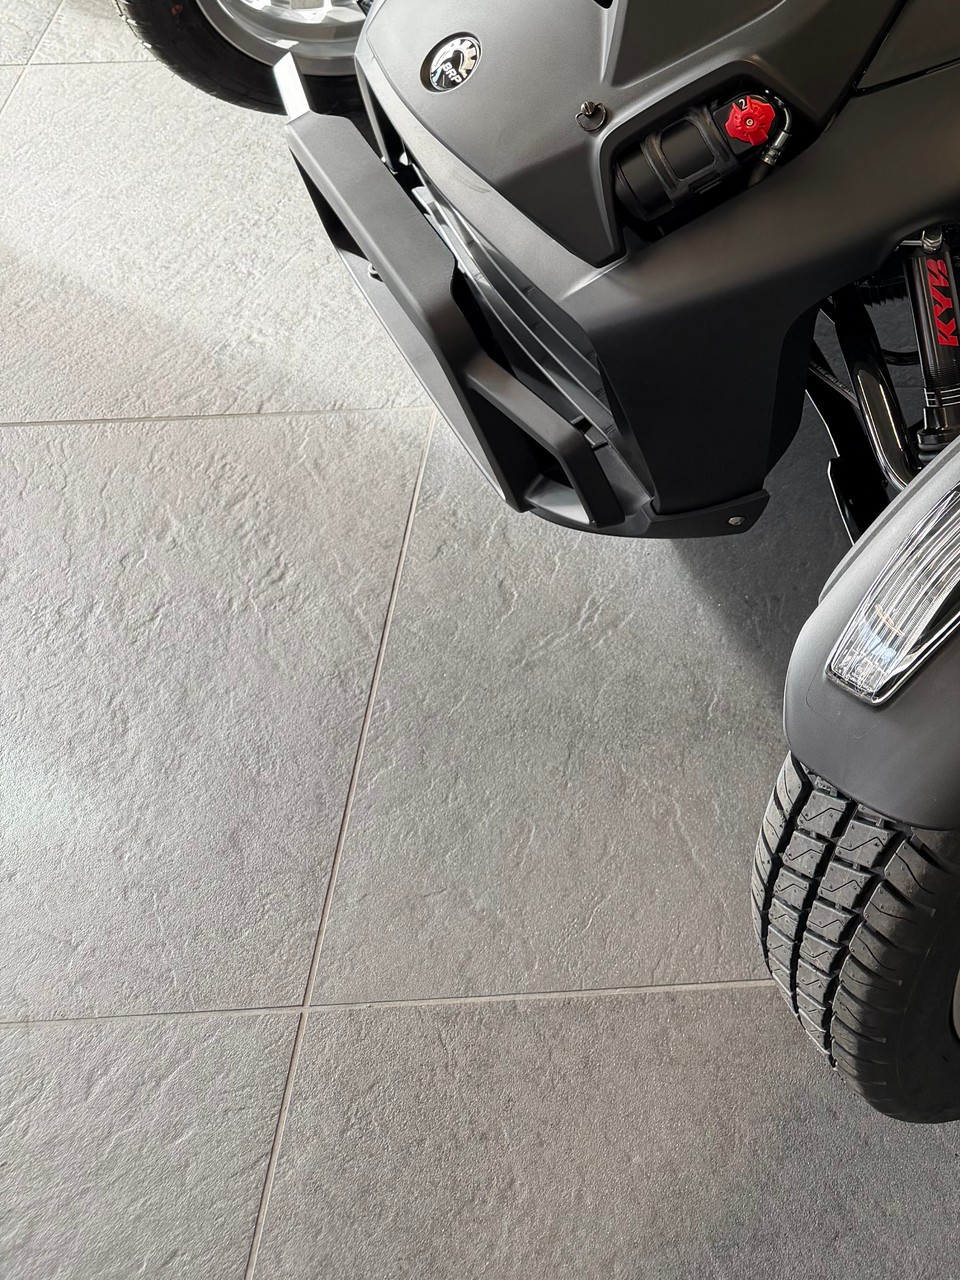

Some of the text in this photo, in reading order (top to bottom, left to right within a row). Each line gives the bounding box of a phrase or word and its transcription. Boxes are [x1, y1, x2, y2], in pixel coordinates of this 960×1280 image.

[442, 61, 463, 83] BRP
[738, 98, 748, 110] 2
[926, 258, 959, 347] KYB
